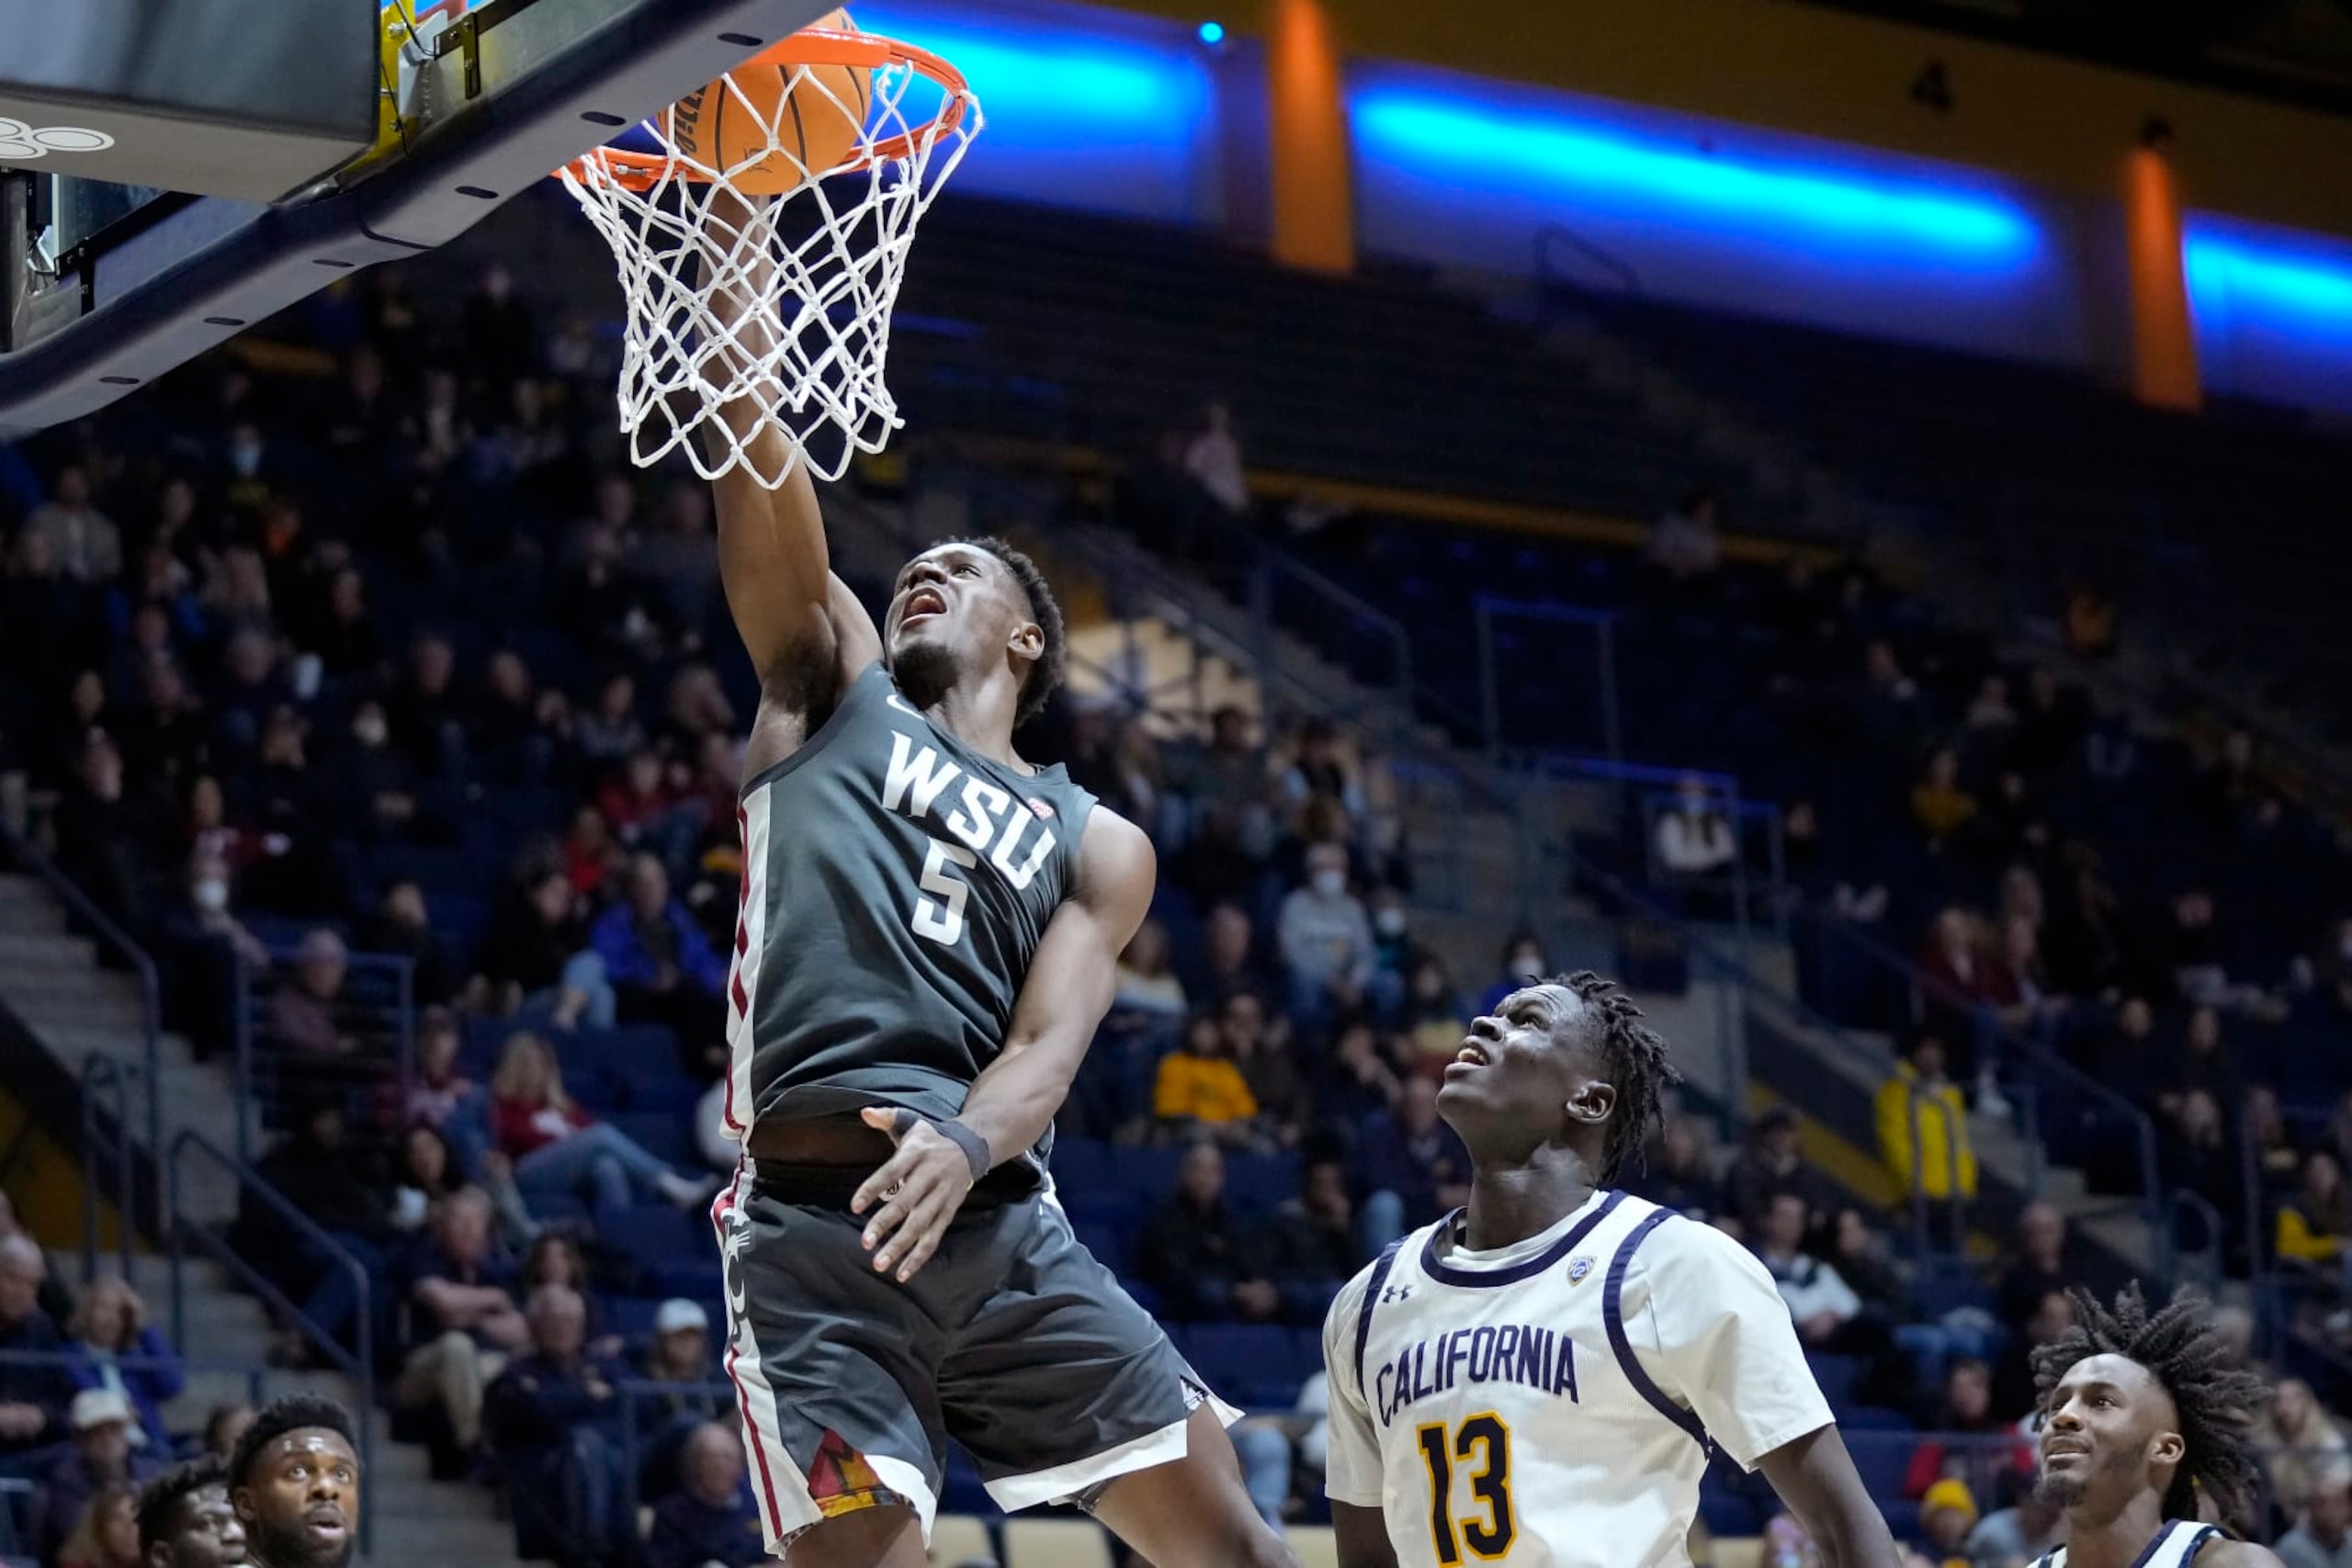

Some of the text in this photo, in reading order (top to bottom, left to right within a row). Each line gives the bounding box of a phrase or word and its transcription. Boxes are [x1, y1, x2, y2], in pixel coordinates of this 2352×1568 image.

[882, 730, 1056, 890] WSU
[910, 836, 977, 946] 5
[1375, 1325, 1579, 1428] CALIFORNIA
[1415, 1410, 1518, 1568] 13
